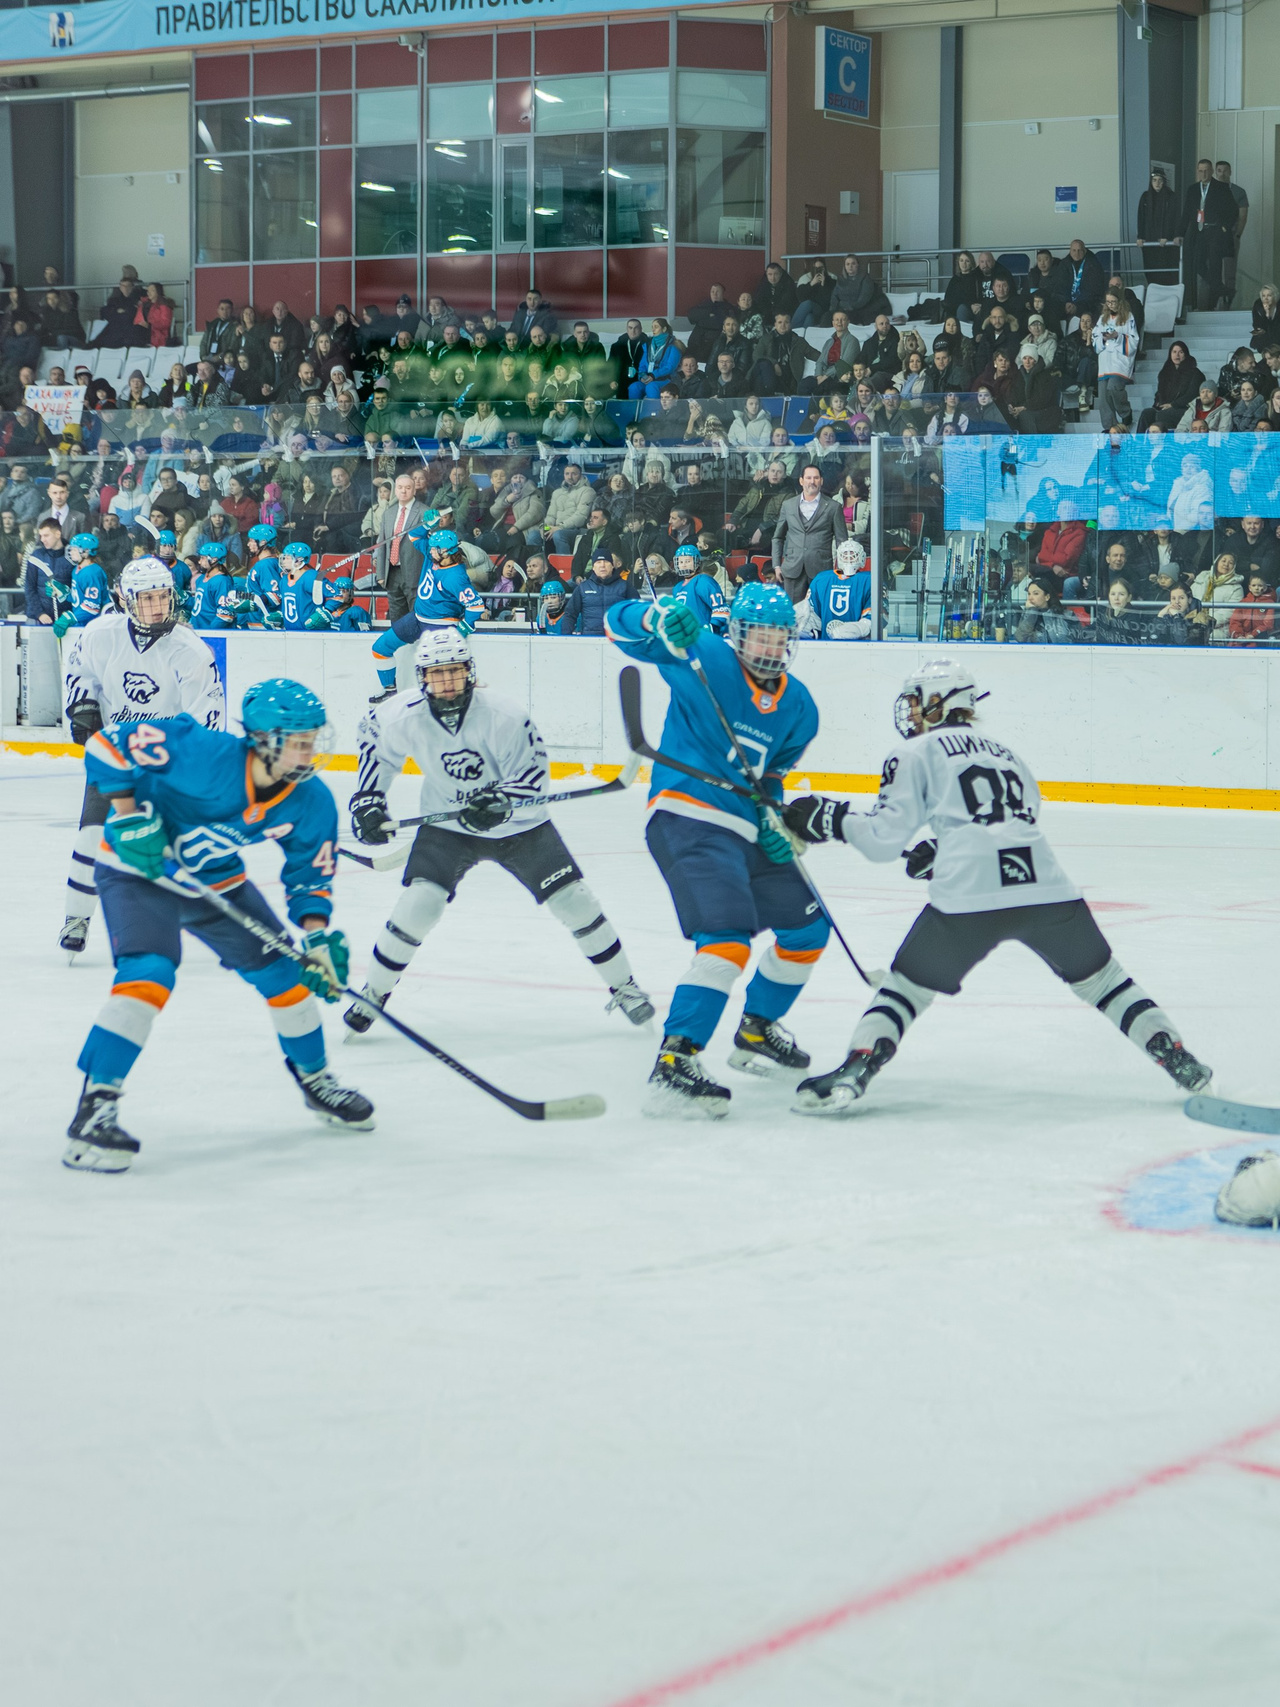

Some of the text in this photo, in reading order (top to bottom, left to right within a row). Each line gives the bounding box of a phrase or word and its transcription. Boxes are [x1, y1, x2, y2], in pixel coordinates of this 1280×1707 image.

[156, 0, 356, 35] ПРАВИТЕЛЬСТВО
[829, 33, 868, 53] СЕКТОР
[827, 92, 866, 112] SECTOR
[84, 587, 99, 600] 13
[459, 588, 476, 604] 43
[710, 593, 724, 607] 17
[129, 723, 170, 767] 42
[349, 796, 387, 813] CCM
[312, 840, 339, 877] 4
[540, 865, 573, 890] CCM
